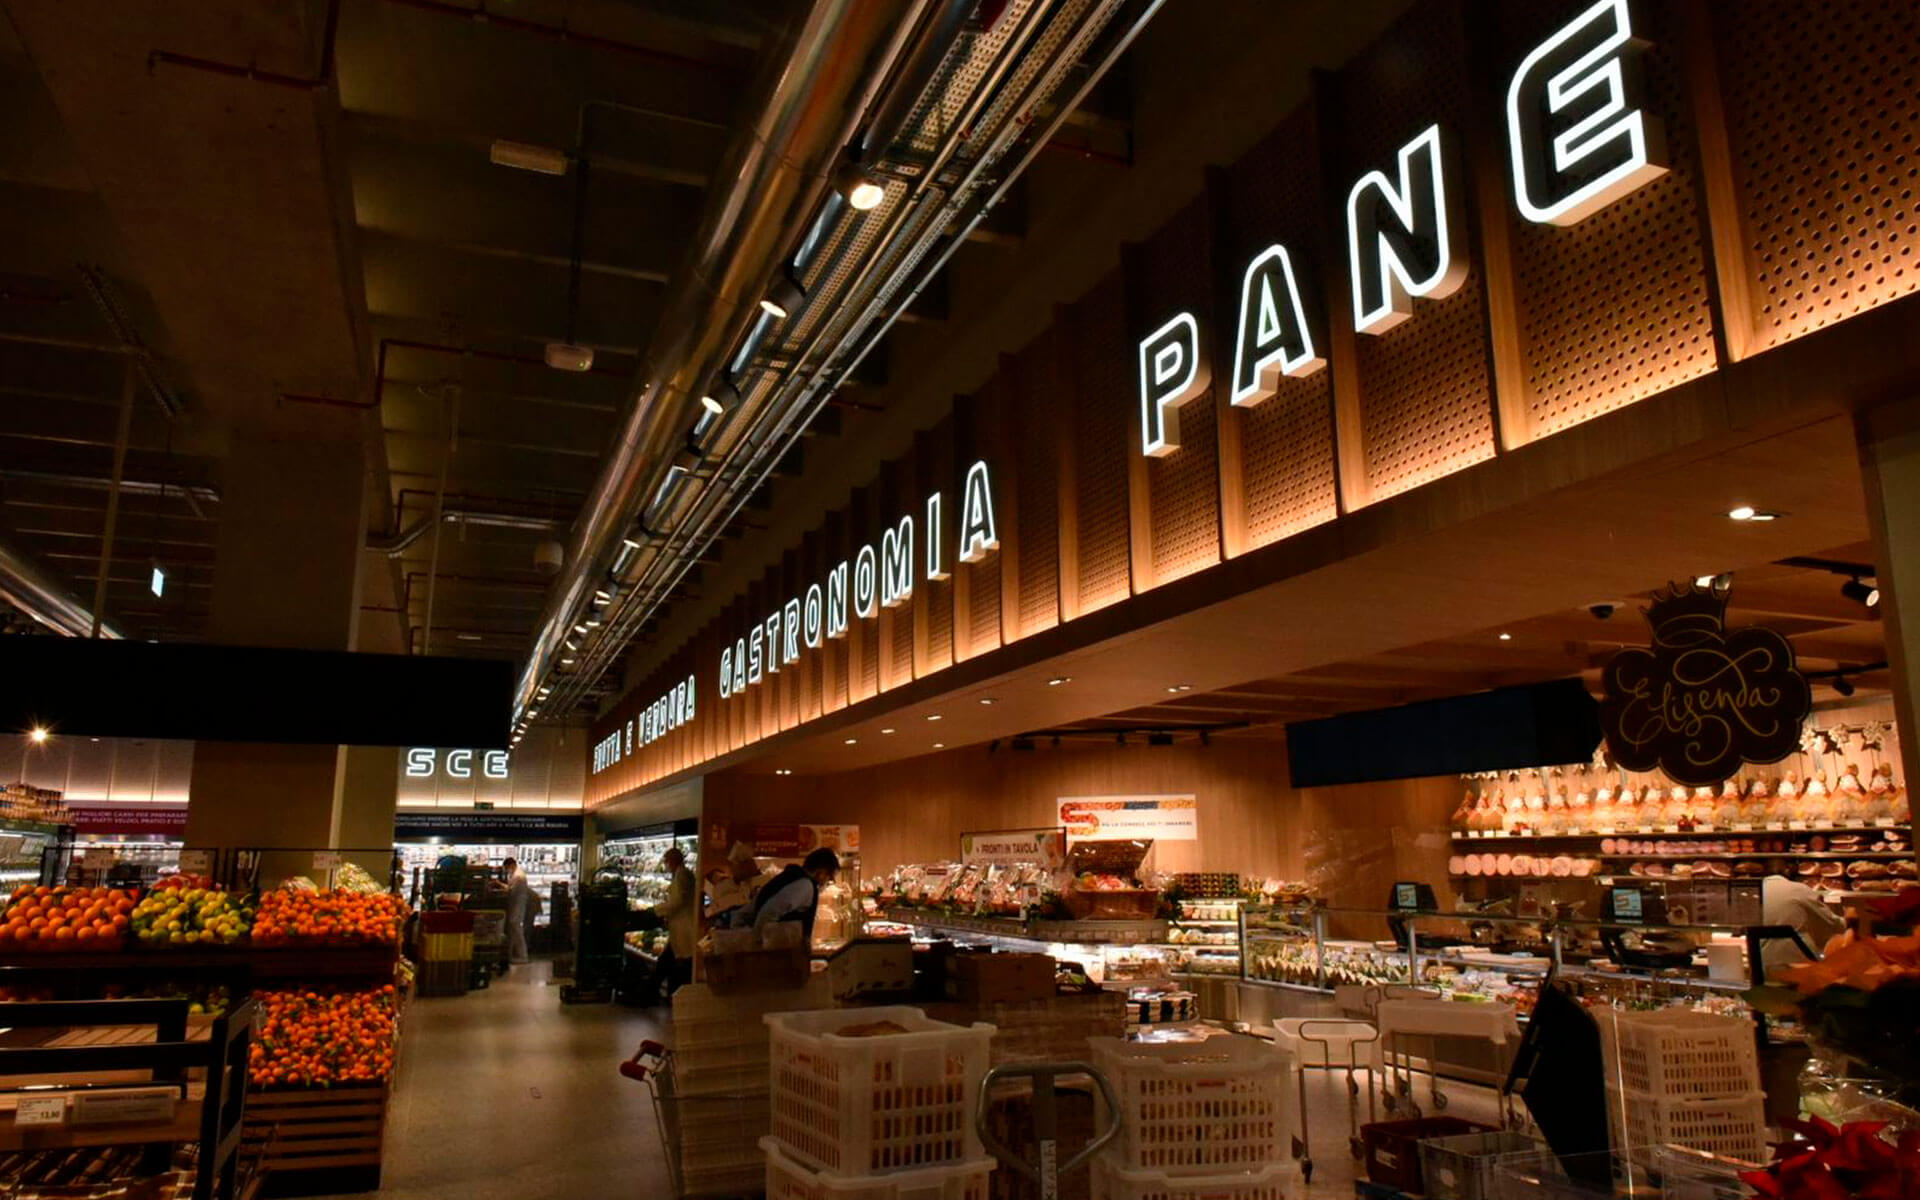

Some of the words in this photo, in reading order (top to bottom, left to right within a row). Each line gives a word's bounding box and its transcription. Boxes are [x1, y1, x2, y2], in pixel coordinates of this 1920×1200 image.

[1140, 0, 1648, 456] PANE
[719, 460, 998, 698] GASTRONOMIA
[406, 748, 509, 778] SCE
[593, 729, 621, 775] FRUTTA
[625, 720, 633, 756] E
[638, 674, 696, 748] VERDURA
[1012, 842, 1038, 854] TAVOLA
